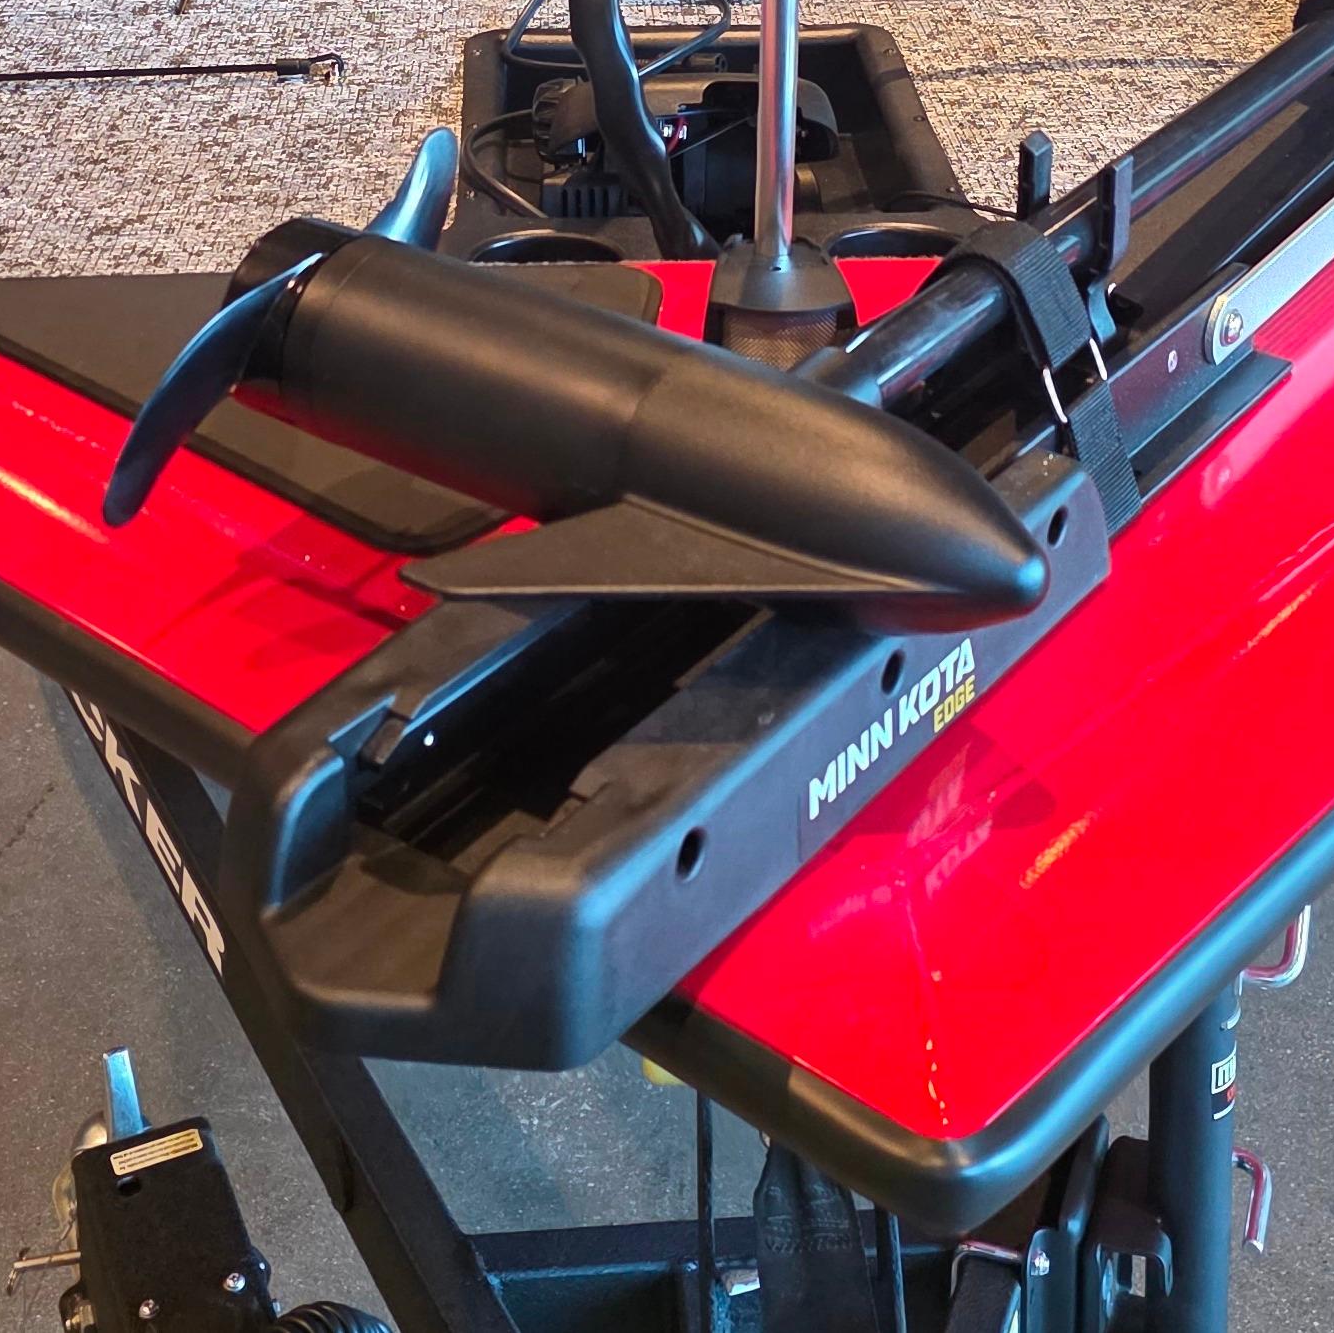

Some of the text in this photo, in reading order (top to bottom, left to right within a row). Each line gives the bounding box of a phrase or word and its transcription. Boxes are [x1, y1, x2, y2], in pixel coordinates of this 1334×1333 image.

[809, 637, 976, 821] MINN KOTA
[933, 674, 976, 733] EDGE
